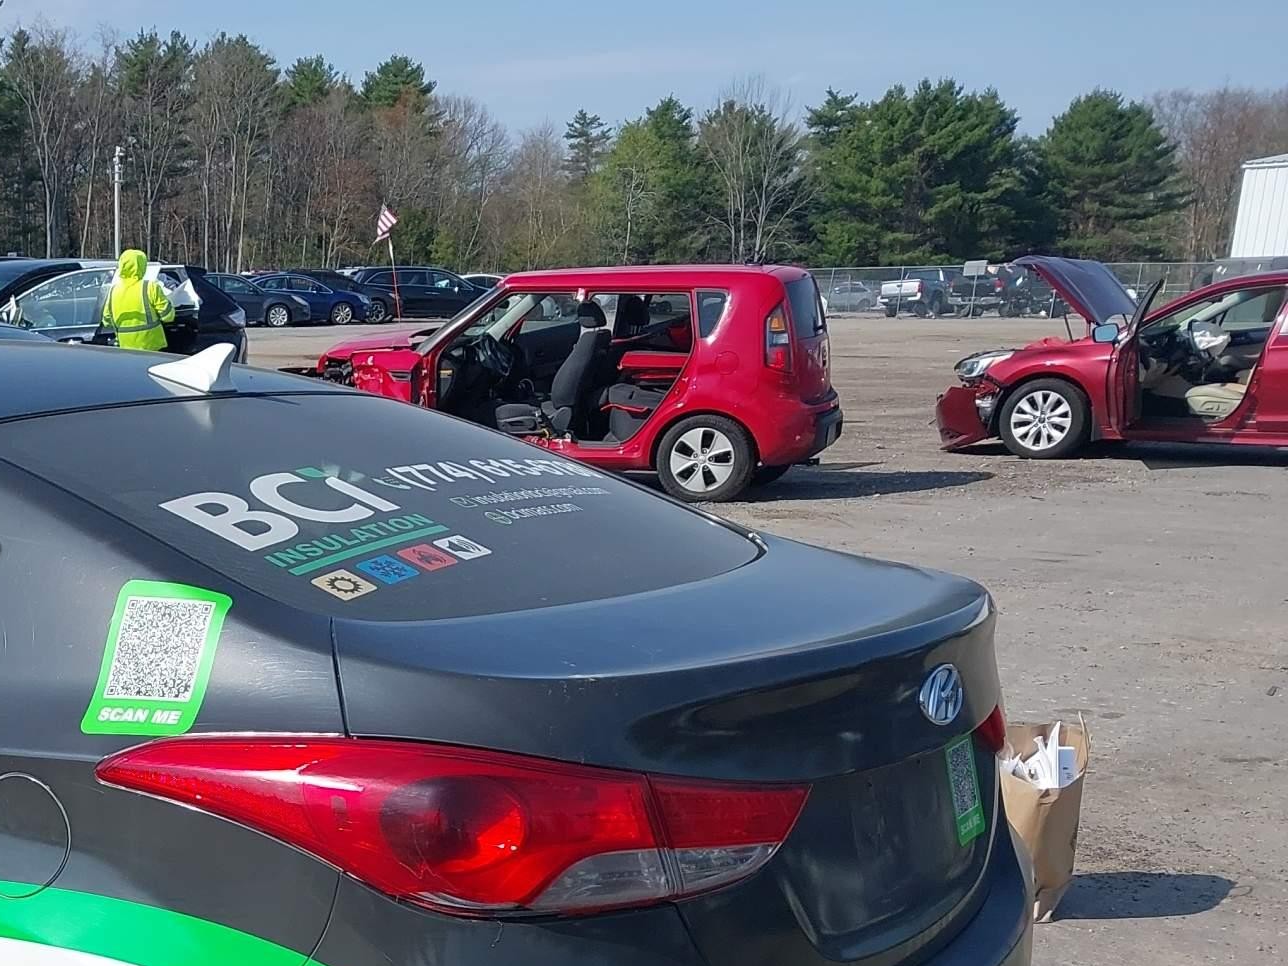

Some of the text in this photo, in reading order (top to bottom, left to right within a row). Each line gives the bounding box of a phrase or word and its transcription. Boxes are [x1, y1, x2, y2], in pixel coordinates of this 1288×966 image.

[385, 461, 497, 492] (774)
[265, 512, 436, 569] INSULATION
[97, 706, 183, 725] SCAN ME
